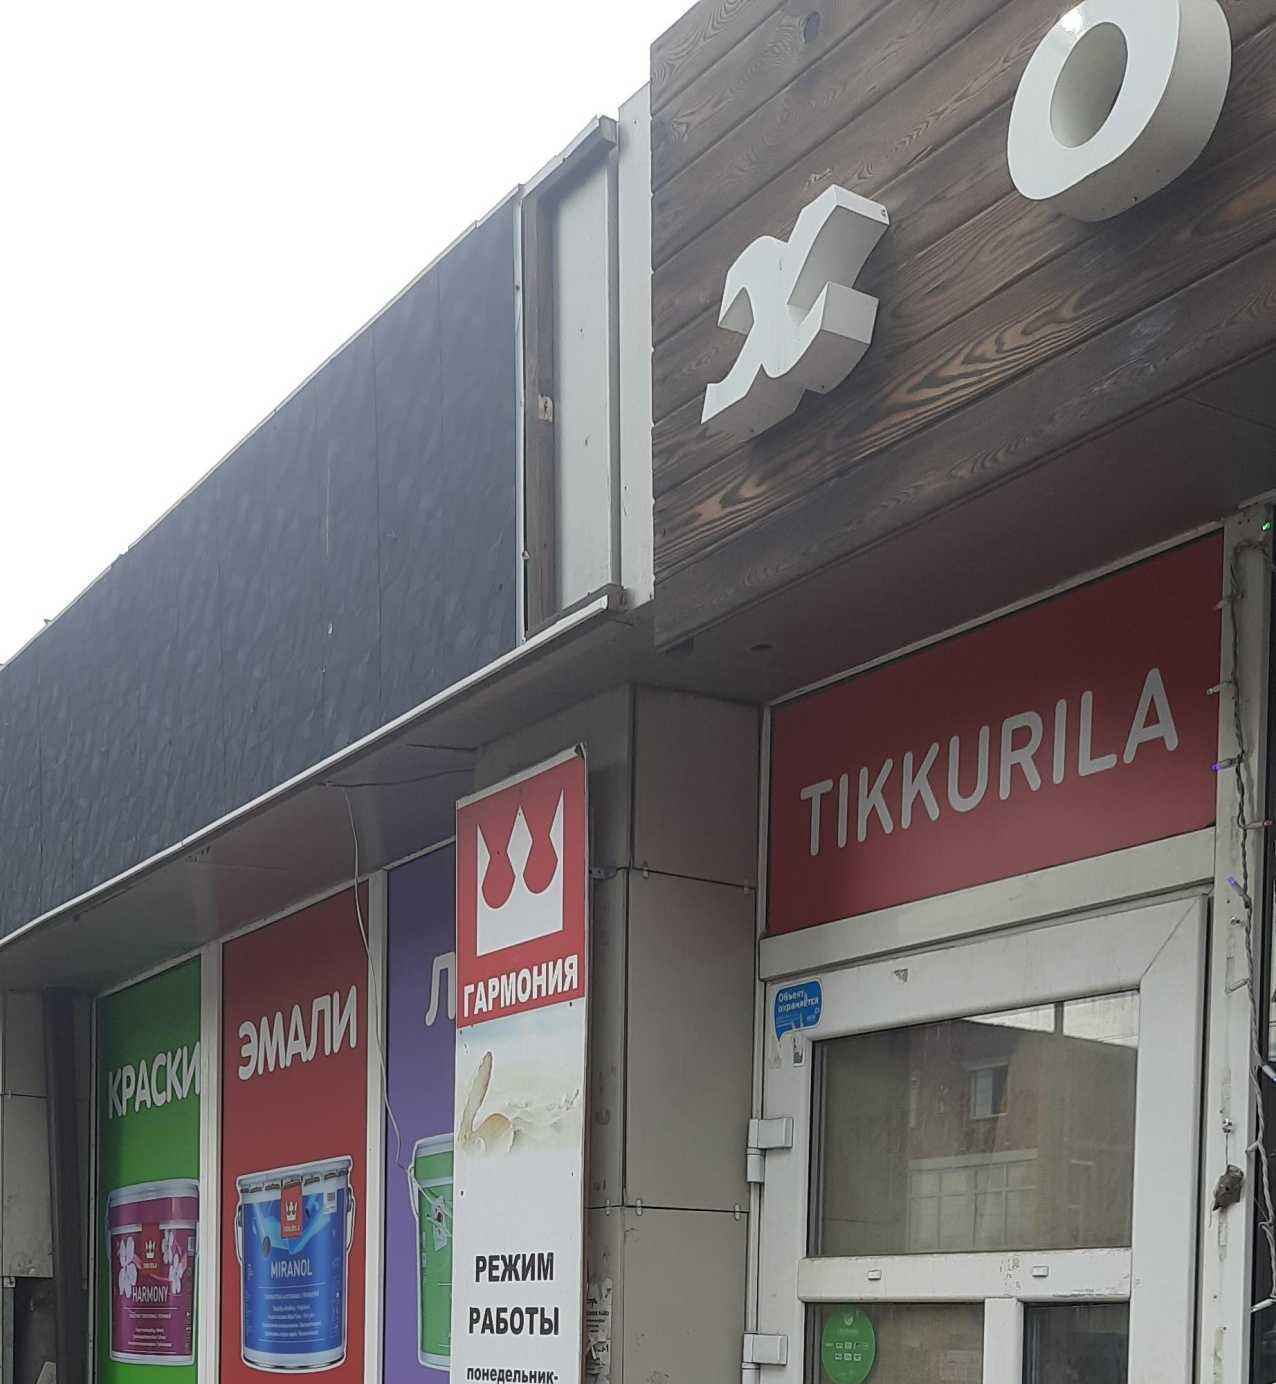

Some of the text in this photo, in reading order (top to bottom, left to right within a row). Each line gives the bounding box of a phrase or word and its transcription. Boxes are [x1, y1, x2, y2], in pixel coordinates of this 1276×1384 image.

[801, 668, 1179, 856] TIKKURILA
[463, 954, 579, 1018] ГАРМОНИЯ
[238, 985, 357, 1080] ЭМАЛИ
[108, 1041, 200, 1119] КРАСКИ
[271, 1258, 313, 1279] MIRANOL
[475, 1252, 554, 1283] РЕЖИМ
[132, 1285, 168, 1303] HARMONY
[468, 1306, 560, 1336] РАБОТЫ
